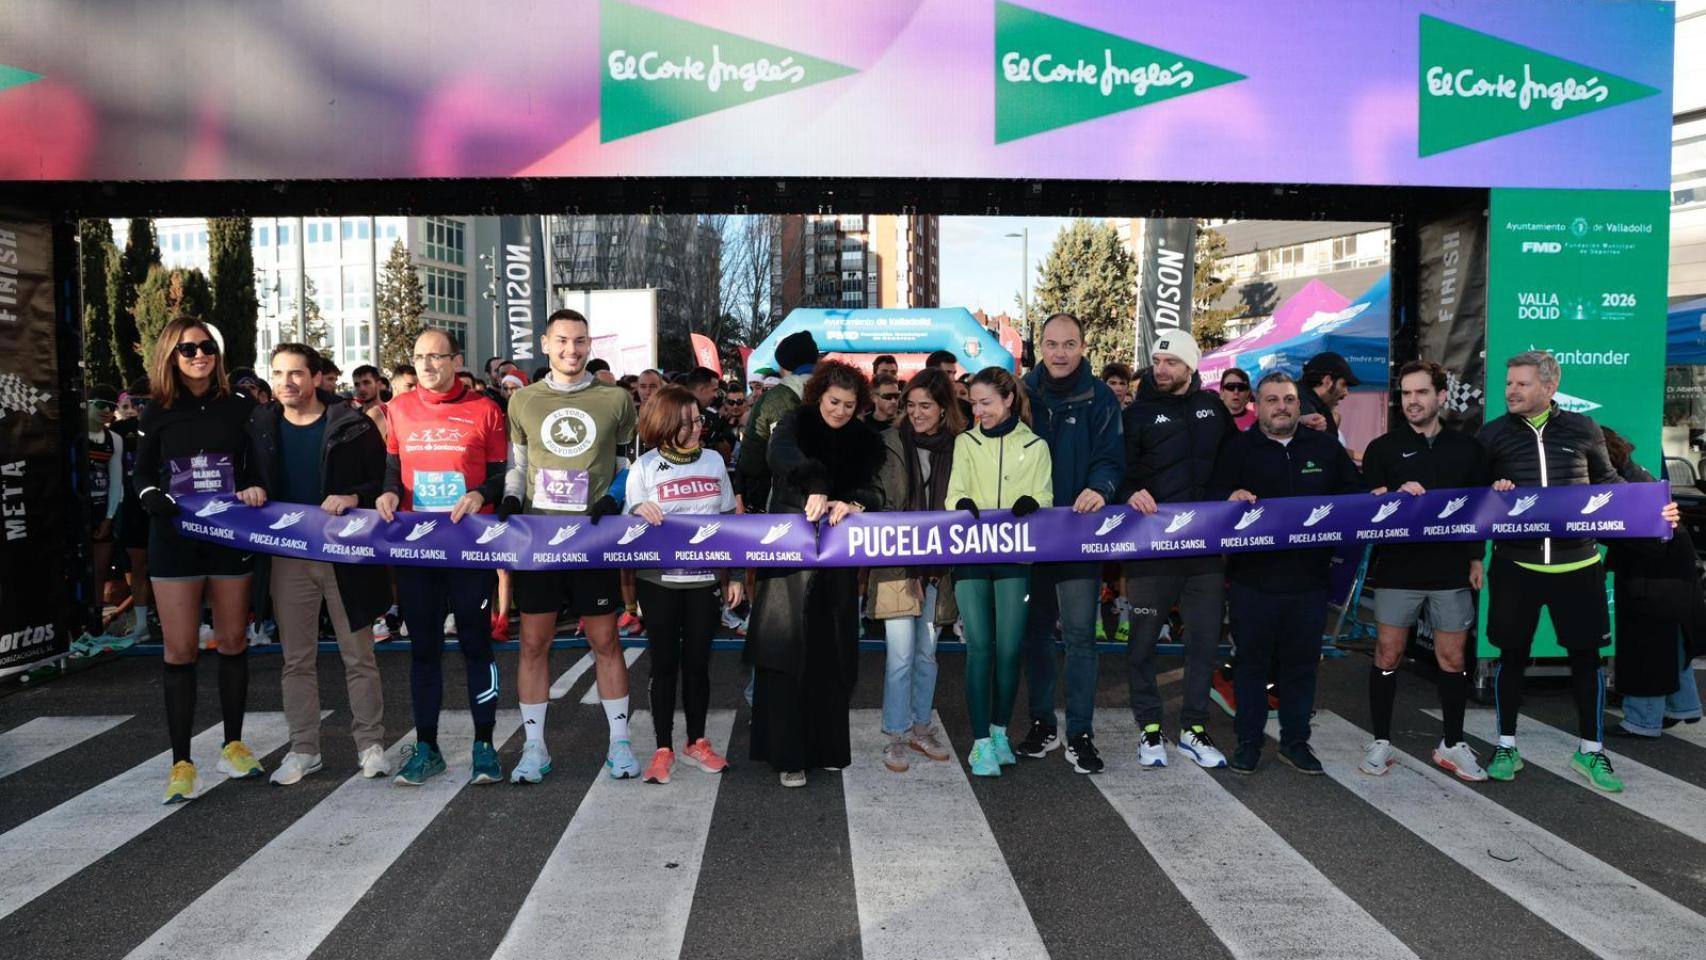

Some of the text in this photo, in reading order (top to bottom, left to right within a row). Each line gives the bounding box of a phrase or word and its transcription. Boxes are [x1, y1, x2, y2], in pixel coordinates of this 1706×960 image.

[608, 44, 805, 92] El Corte Inglés
[1002, 48, 1194, 96] El Corte Inglés
[1427, 63, 1608, 111] El Corte Inglés
[1506, 222, 1652, 233] Ayuntamiento de Valladolid
[1522, 241, 1562, 253] FMD
[1439, 231, 1460, 322] FINISH
[1155, 248, 1184, 336] DISON
[1518, 293, 1559, 305] VALLA
[1601, 293, 1637, 306] 2026
[1518, 306, 1560, 319] DOLID
[889, 317, 932, 326] Valladolid
[1546, 349, 1630, 366] antander
[565, 409, 586, 419] TORO
[192, 470, 221, 479] BLANCA
[418, 483, 458, 497] 3312
[546, 482, 574, 495] 427
[662, 480, 721, 498] Helios
[1, 459, 28, 541] META
[181, 520, 235, 540] PUCELA SANSIL
[1423, 523, 1478, 536] PUCELA SANSIL
[1492, 522, 1551, 533] PUCELA SANSIL
[1566, 520, 1626, 532] PUCELA SANSIL
[847, 522, 1036, 558] PUCELA SANSIL
[1288, 531, 1343, 544] PUCELA SANSIL
[1356, 527, 1410, 540] PUCELA SANSIL
[249, 532, 308, 551] PUCELA SANSIL
[1081, 541, 1137, 554] PUCELA SANSIL
[1150, 539, 1206, 552] PUCELA SANSIL
[1220, 535, 1275, 548] PUCELA SANSIL
[322, 542, 376, 558] PUCELA SANSIL
[389, 545, 448, 560] PUCELA SANSIL
[461, 550, 519, 563] PUCELA SANSIL
[603, 551, 661, 562] PUCELA SANSIL
[675, 550, 732, 561] PUCELA SANSIL
[746, 551, 803, 562] PUCELA SANSIL
[532, 551, 589, 563] PUCELA SANSIL
